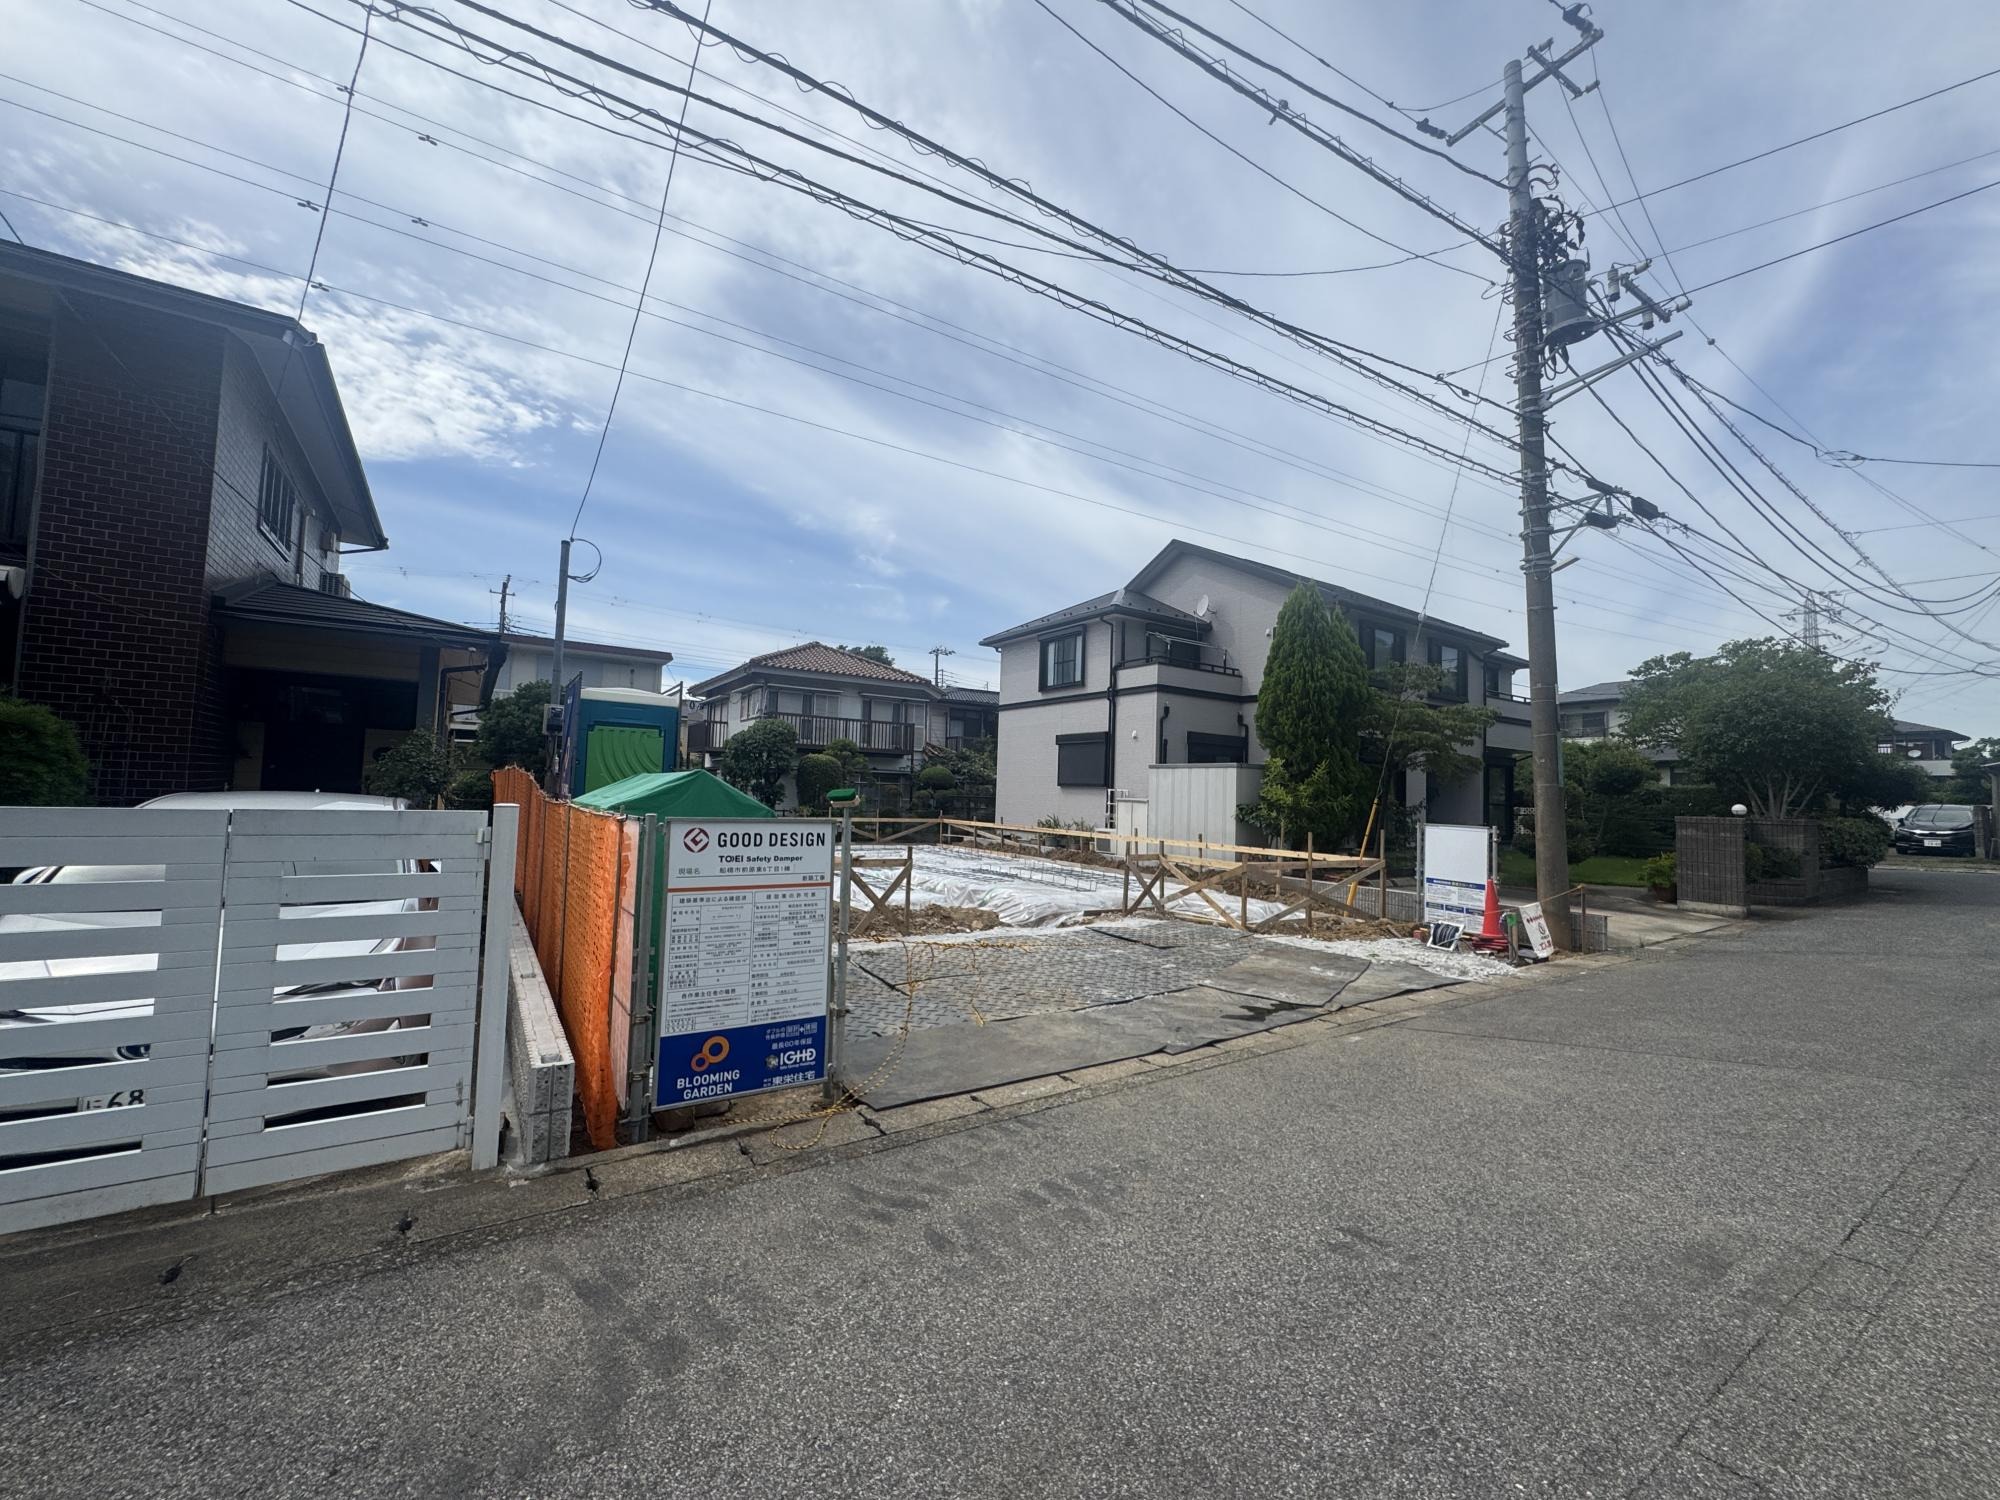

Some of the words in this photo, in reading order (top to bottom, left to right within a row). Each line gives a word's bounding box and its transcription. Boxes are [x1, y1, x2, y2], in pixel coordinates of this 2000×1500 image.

[717, 832, 763, 848] GOOD
[769, 832, 826, 847] DESIGN
[746, 855, 772, 863] Safety
[773, 855, 803, 863] Damper
[676, 1069, 740, 1089] BLOOMING
[683, 1082, 733, 1100] GARDEN
